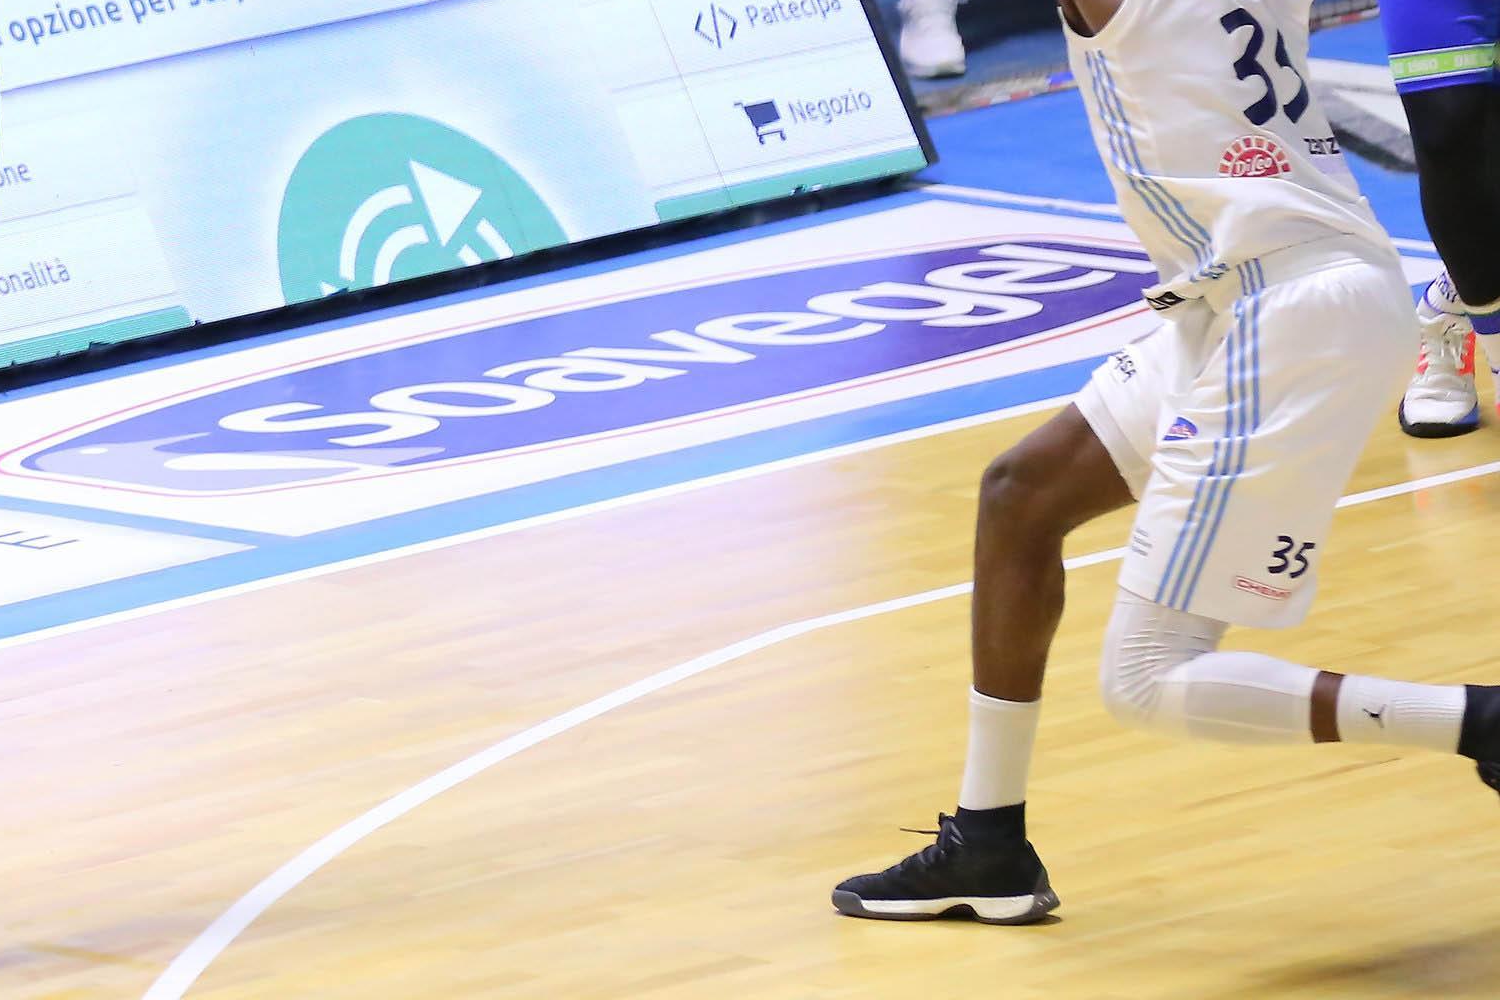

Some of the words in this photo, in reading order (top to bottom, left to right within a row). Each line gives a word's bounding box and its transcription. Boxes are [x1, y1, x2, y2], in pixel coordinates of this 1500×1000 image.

[8, 0, 123, 45] opzione
[787, 87, 873, 124] Negozio
[1266, 535, 1317, 579] 35
